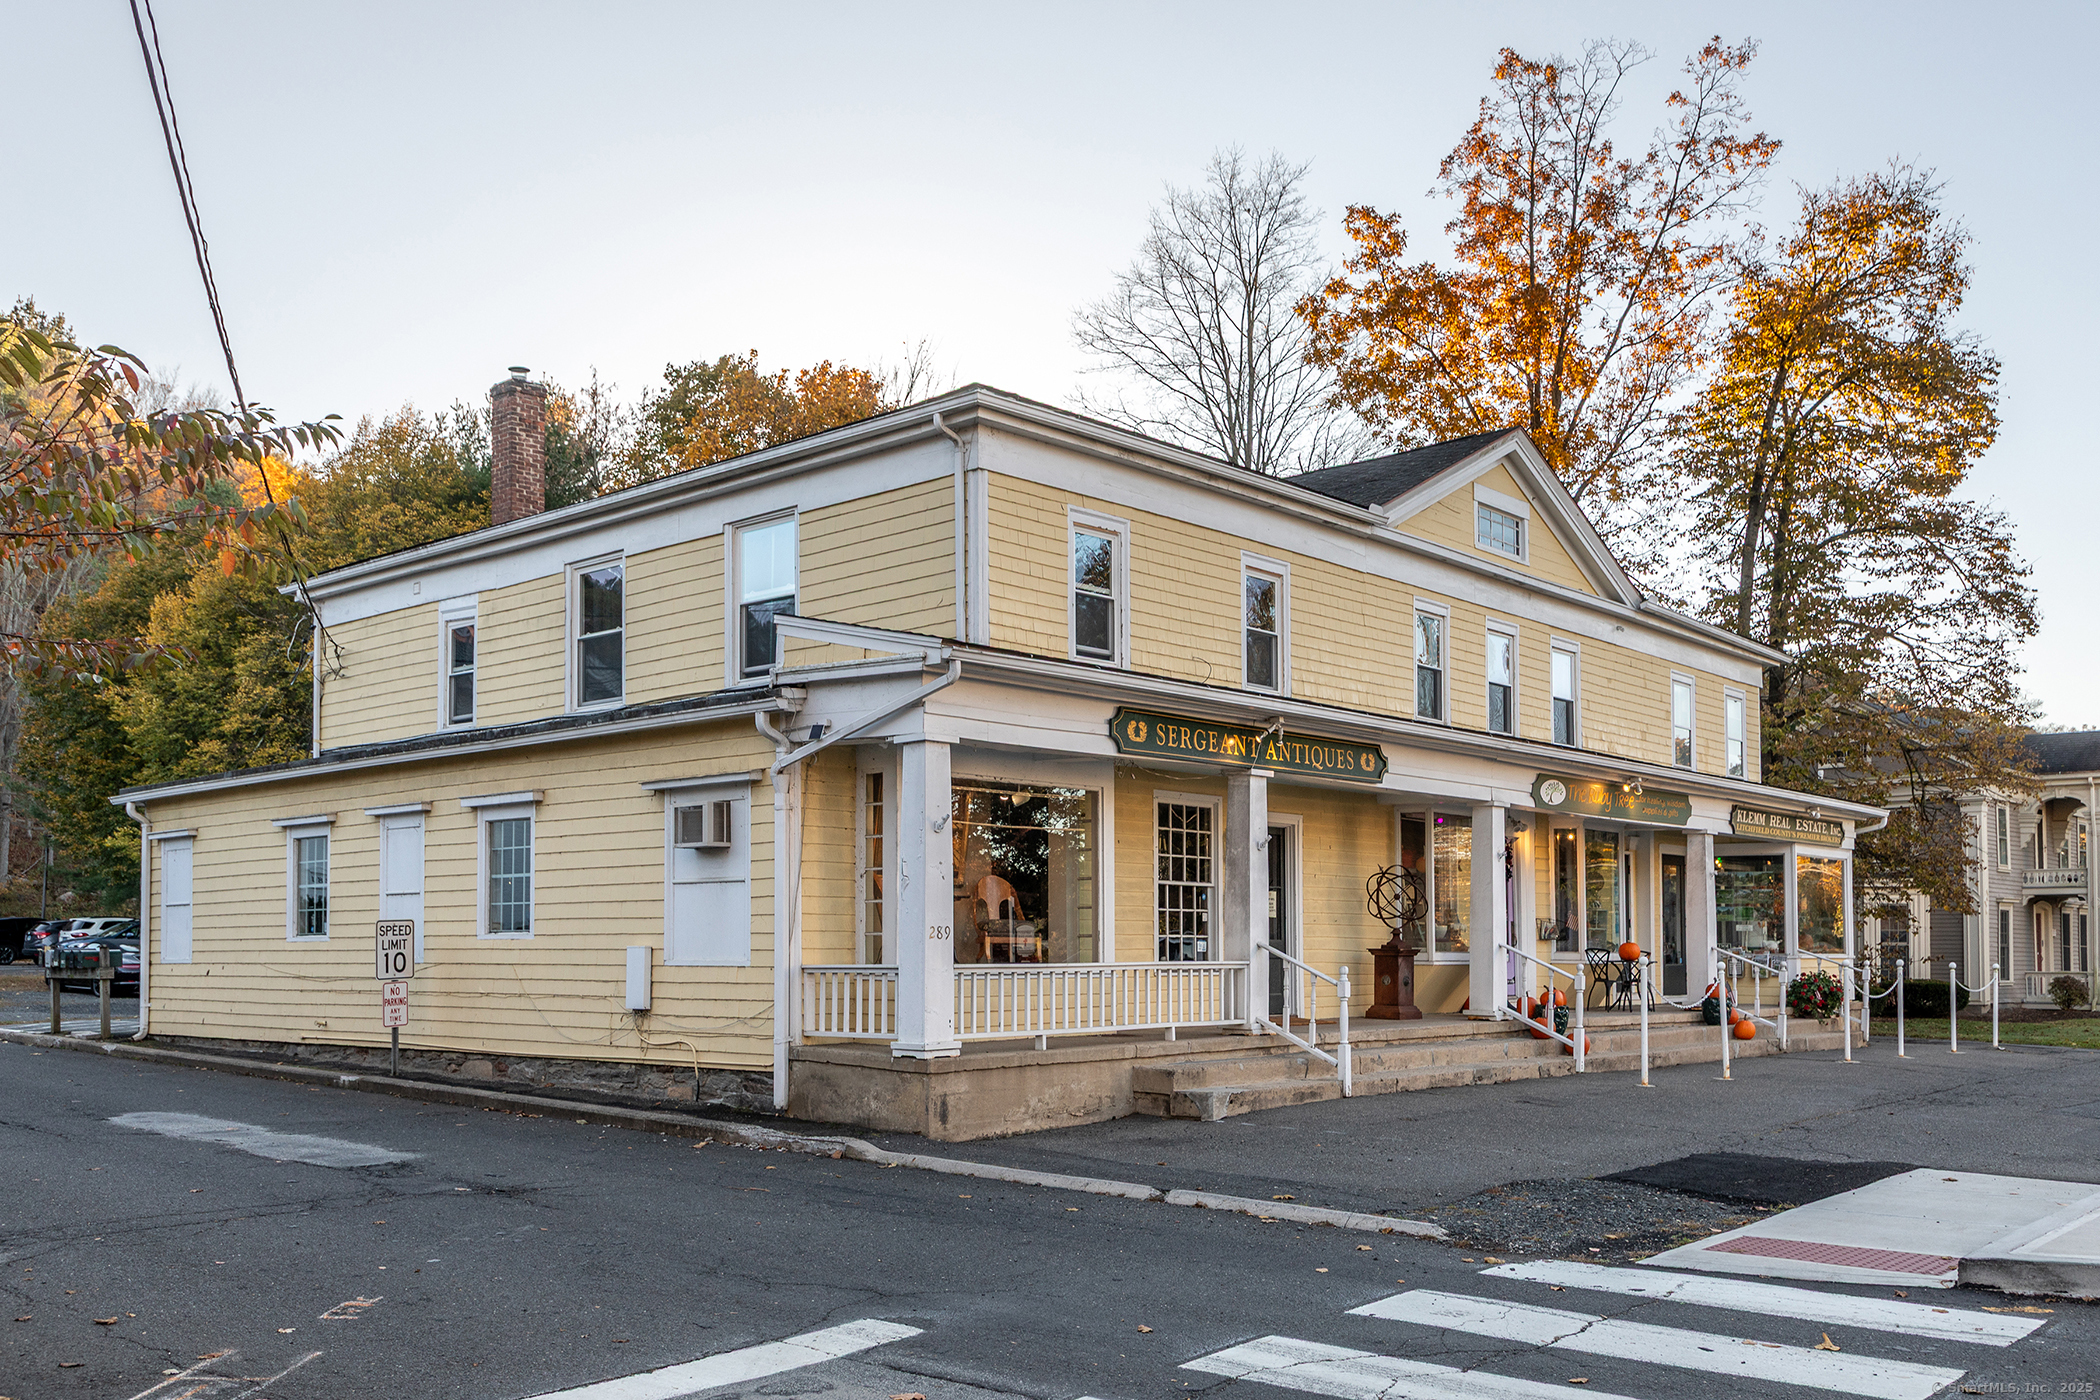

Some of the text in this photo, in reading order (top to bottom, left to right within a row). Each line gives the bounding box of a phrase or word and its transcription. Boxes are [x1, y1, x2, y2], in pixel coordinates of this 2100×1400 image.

[1156, 723, 1355, 770] SERGEANT ANTIQUES
[1568, 784, 1586, 803] The
[1589, 787, 1612, 812] Ruby
[1737, 810, 1766, 826] KLEMM
[1770, 815, 1791, 829] REAL
[1796, 819, 1828, 834] ESTATE,
[1736, 823, 1841, 843] LITCHFIELD COUNTY'S PREMIER BROKERS
[379, 925, 412, 936] SPEED
[929, 926, 951, 940] 289
[381, 939, 408, 950] LIMIT
[384, 952, 406, 973] 10
[390, 986, 400, 996] NO
[384, 997, 407, 1007] PARKING
